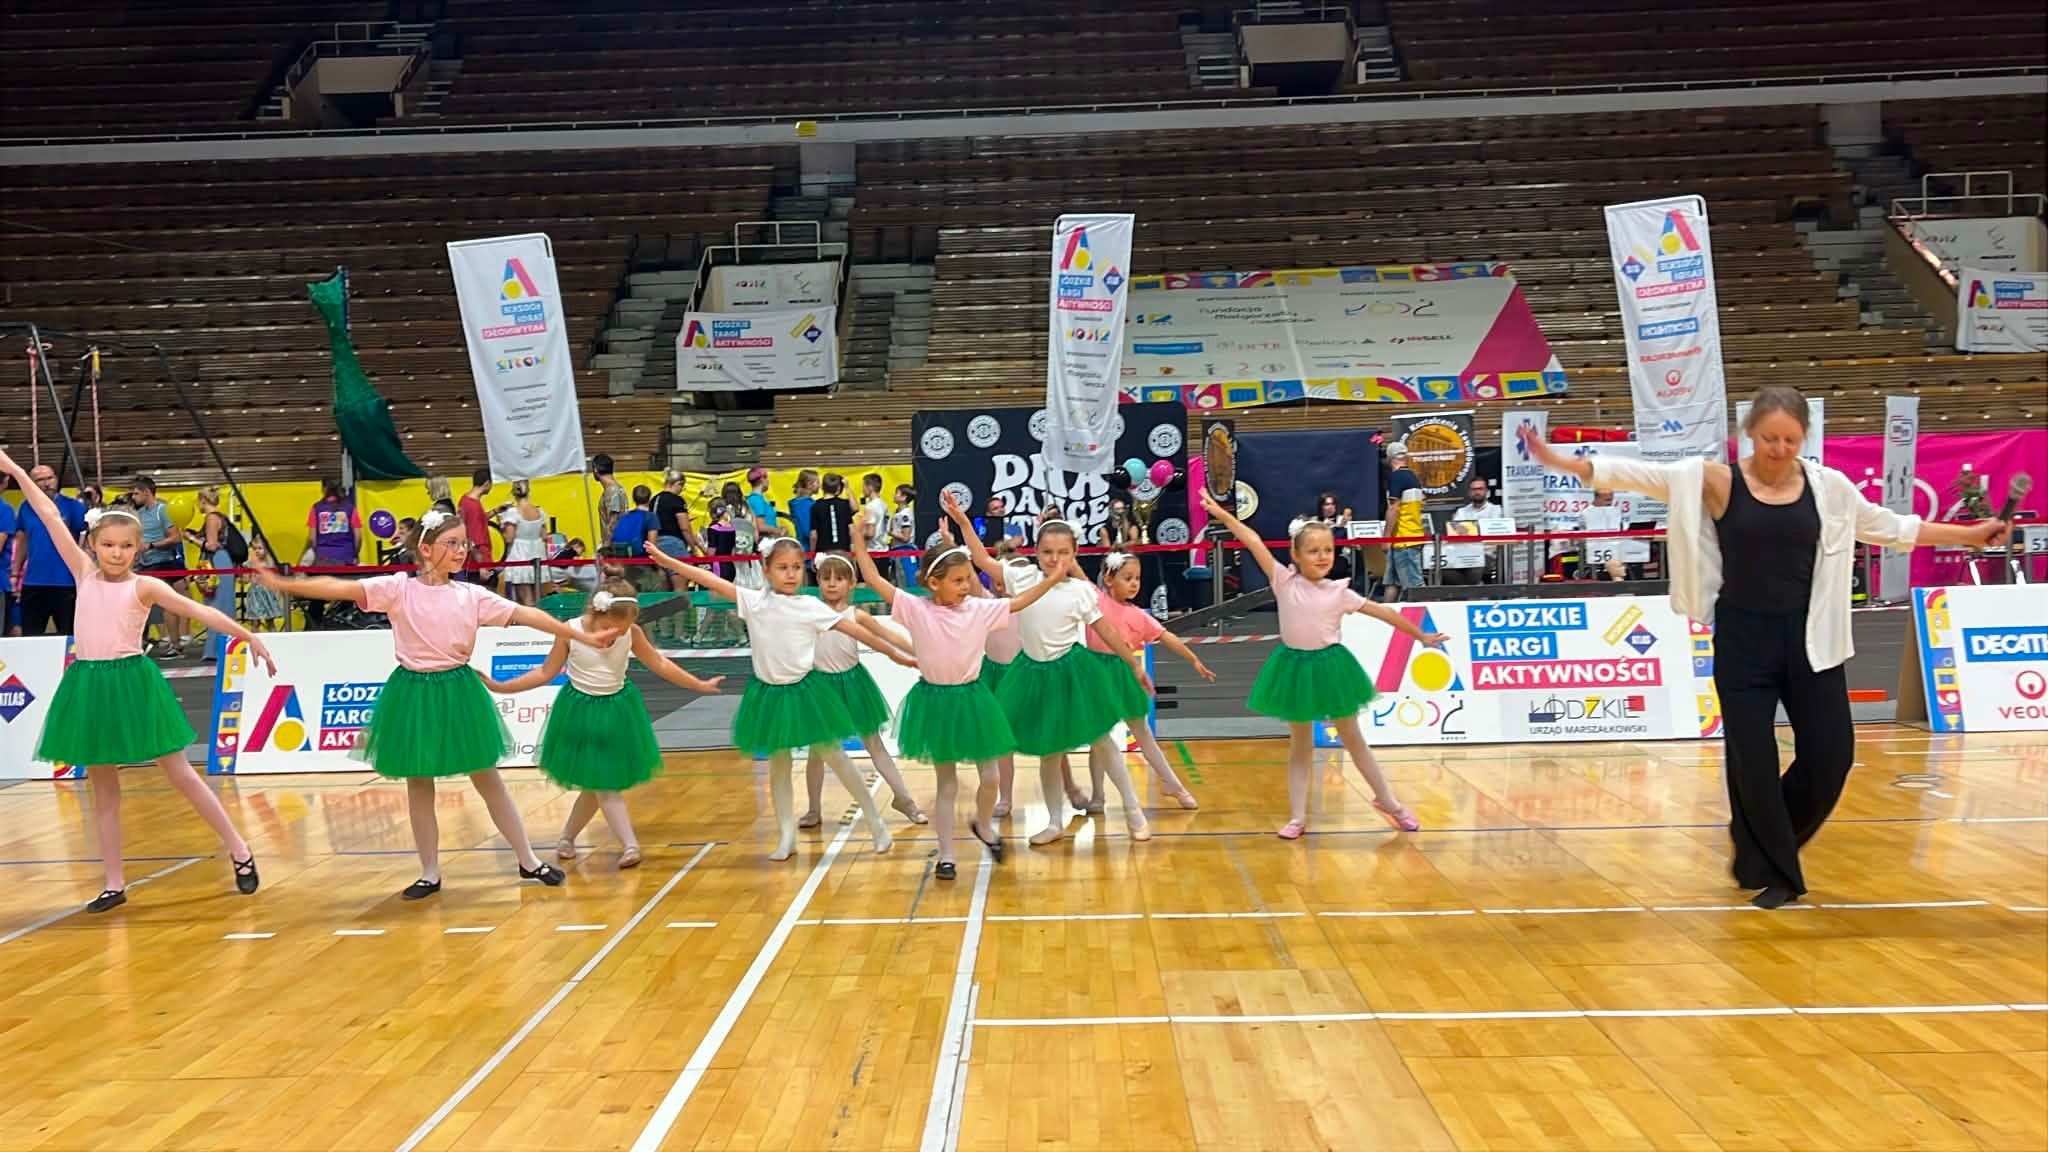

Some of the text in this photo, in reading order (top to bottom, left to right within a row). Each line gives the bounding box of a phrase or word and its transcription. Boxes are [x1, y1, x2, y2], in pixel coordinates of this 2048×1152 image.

[1594, 550, 1612, 562] 56
[1473, 603, 1582, 628] ŁÓDZKIE
[1474, 637, 1550, 656] TARGI
[1478, 657, 1655, 685] AKTYWNOŚCI
[1530, 726, 1562, 735] URZĄD
